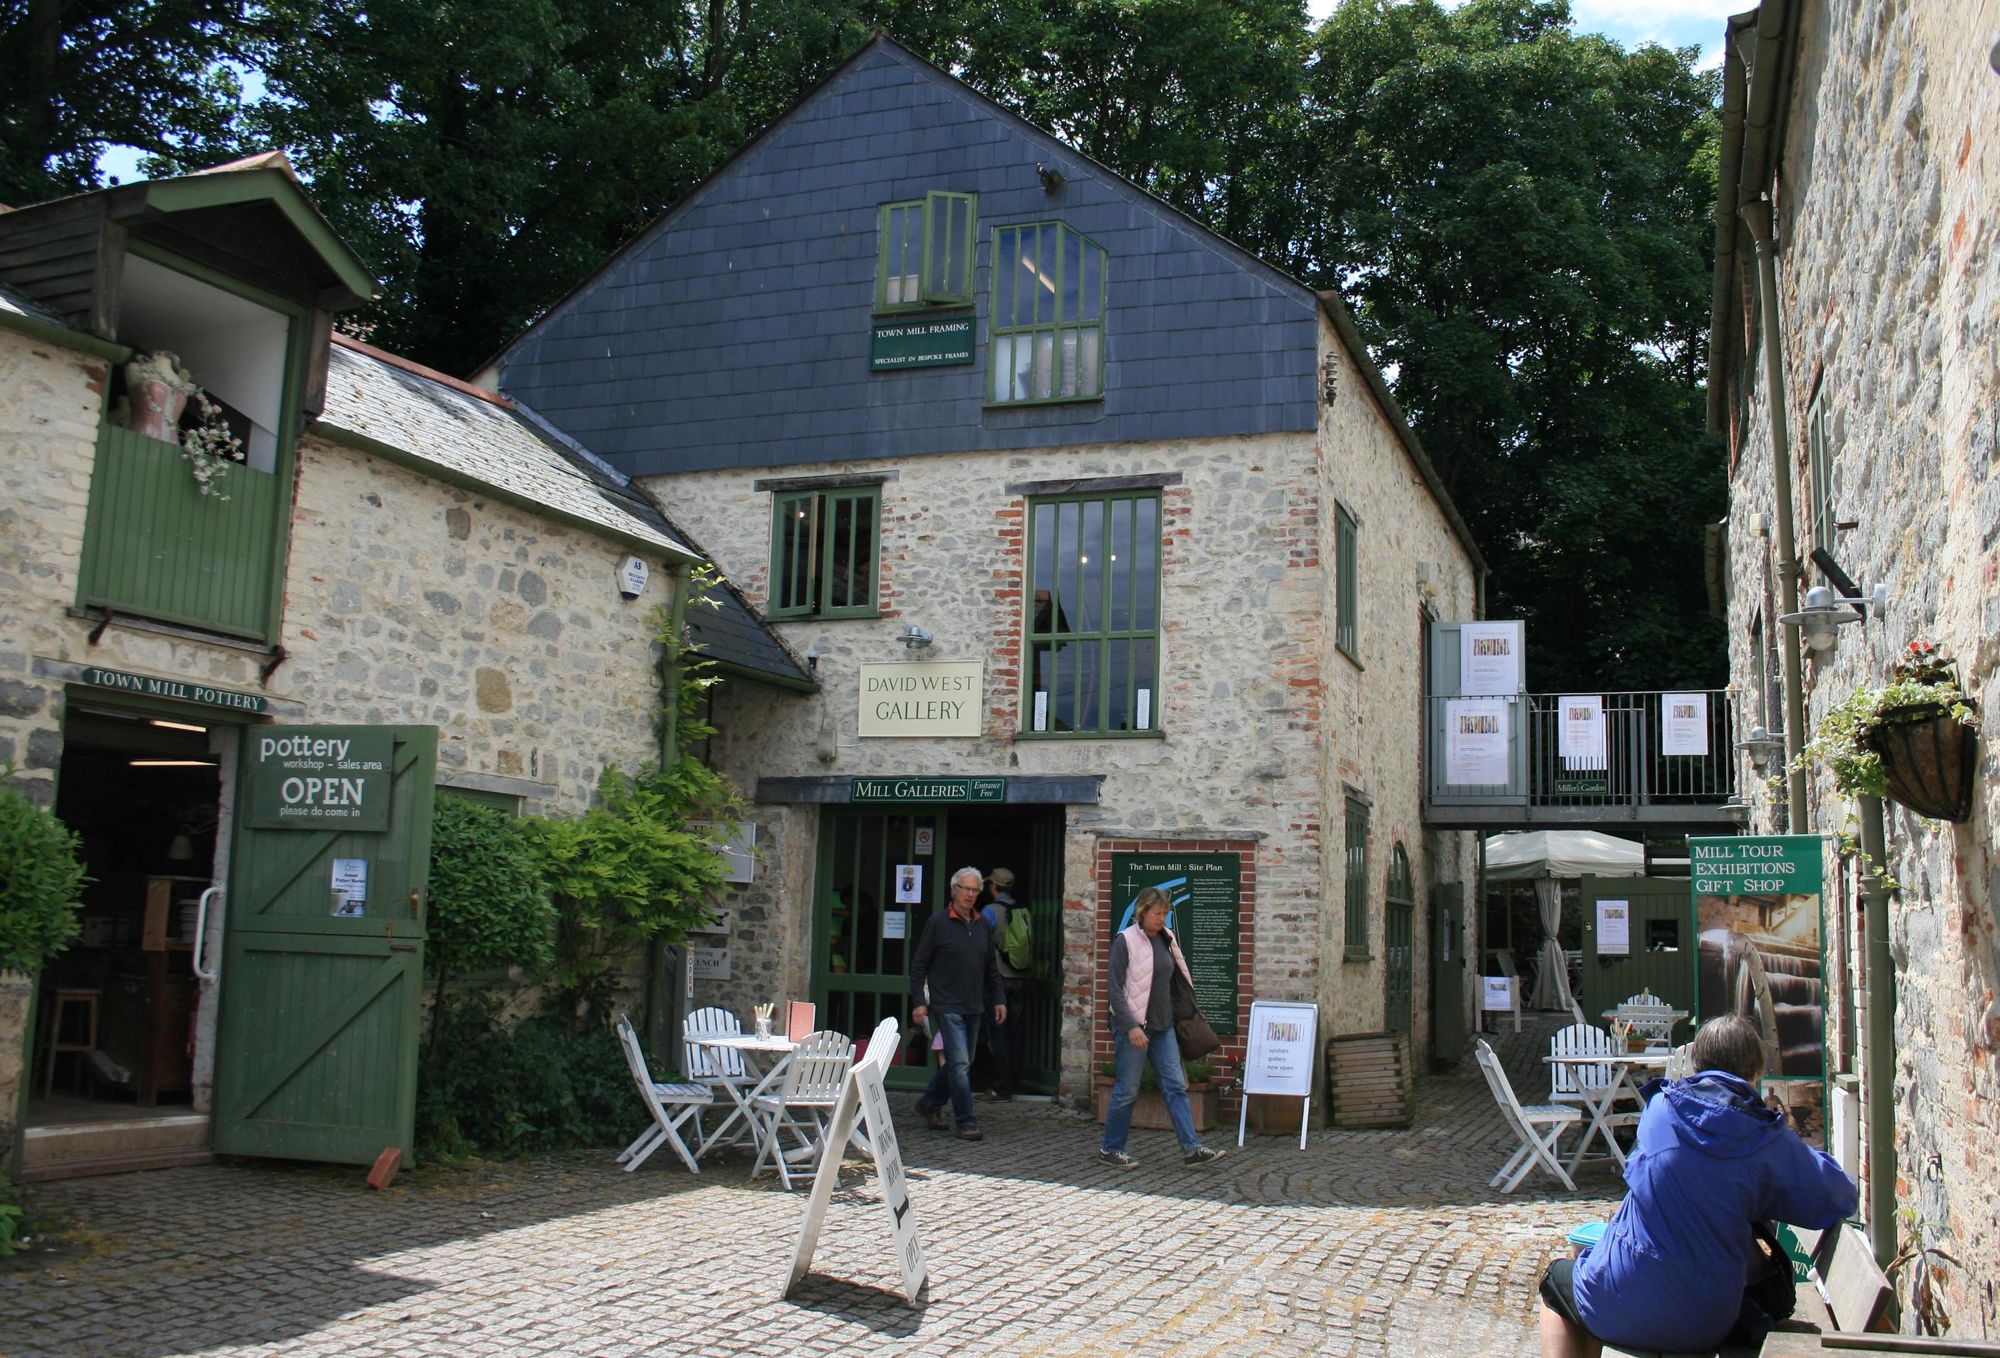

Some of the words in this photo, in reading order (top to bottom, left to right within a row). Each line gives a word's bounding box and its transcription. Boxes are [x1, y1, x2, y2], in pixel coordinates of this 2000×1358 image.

[876, 328, 904, 338] TOWN
[906, 326, 927, 336] MILL
[929, 322, 969, 334] FRAMING
[874, 356, 906, 365] SPECIALIST
[94, 669, 144, 691] TOWN
[149, 679, 188, 699] MILL
[194, 687, 261, 711] POTTERY
[867, 677, 917, 692] DAVID
[921, 675, 976, 692] WEST
[875, 700, 966, 721] GALLERY
[260, 735, 351, 763] pottery
[283, 758, 325, 772] workshop
[337, 758, 361, 770] sales
[362, 761, 383, 770] area
[282, 777, 366, 806] OPEN
[855, 782, 891, 797] MILL
[895, 781, 966, 797] GALLERIES
[974, 781, 1001, 789] Entrance
[980, 789, 993, 797] Free
[280, 805, 309, 816] please
[311, 805, 323, 816] do
[325, 808, 349, 816] come
[351, 807, 361, 816] in
[1695, 846, 1734, 859] MILL
[1738, 844, 1784, 858] TOUR
[1129, 863, 1143, 871] The
[1145, 863, 1165, 871] Town
[1167, 863, 1182, 871] Mill
[1188, 863, 1203, 871] Site
[1205, 864, 1223, 872] Plan
[1695, 861, 1795, 876] EXHIBITIONS
[1695, 879, 1733, 892] GIFT
[1744, 878, 1785, 892] SHOP
